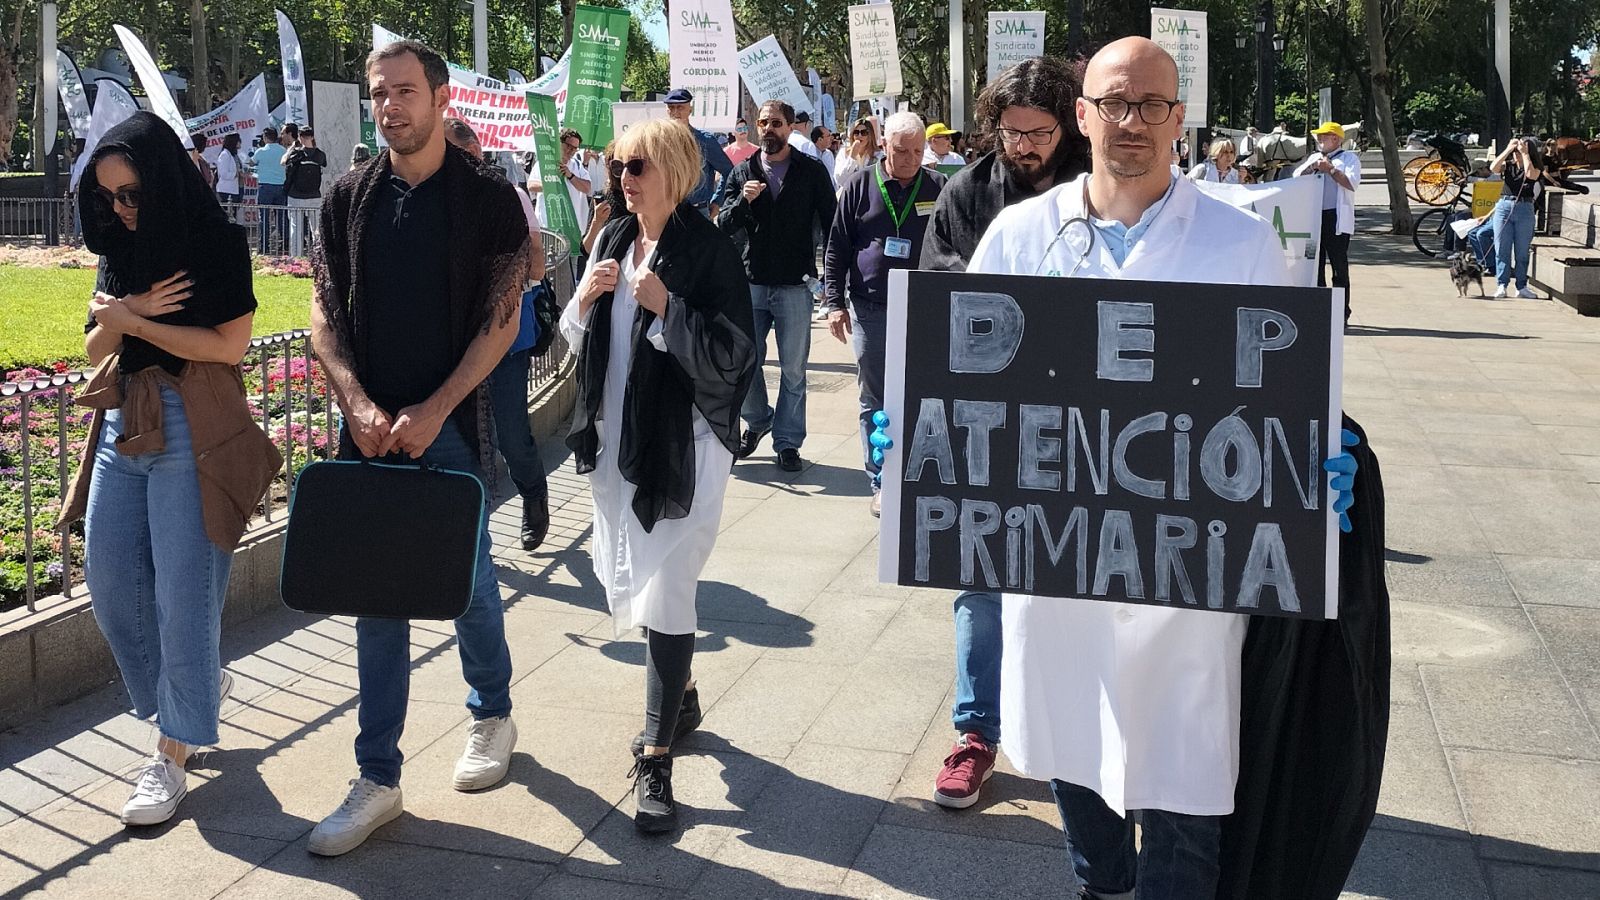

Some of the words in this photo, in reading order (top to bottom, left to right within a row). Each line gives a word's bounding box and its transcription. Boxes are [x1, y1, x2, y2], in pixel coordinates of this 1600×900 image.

[682, 10, 719, 29] SMA
[855, 11, 887, 27] SMA
[995, 19, 1035, 36] SMA
[1158, 17, 1198, 36] SMA
[578, 23, 618, 42] SMA
[856, 31, 889, 40] Sindicato
[995, 42, 1036, 50] Sindicato
[1158, 40, 1199, 51] Sindicato
[580, 51, 616, 62] SINDICATO
[740, 48, 774, 69] SMA
[860, 50, 890, 59] Andaluz
[1170, 52, 1195, 62] édico
[748, 61, 781, 79] Sindicato
[864, 60, 888, 70] Jaén
[1179, 64, 1197, 74] aluz
[580, 69, 612, 78] ANDALUZ
[476, 76, 500, 90] POR
[576, 78, 613, 89] CÓRDOBA
[759, 77, 787, 94] Andaluz
[1179, 75, 1193, 88] én
[220, 124, 235, 134] LOS
[1475, 199, 1496, 207] Glo
